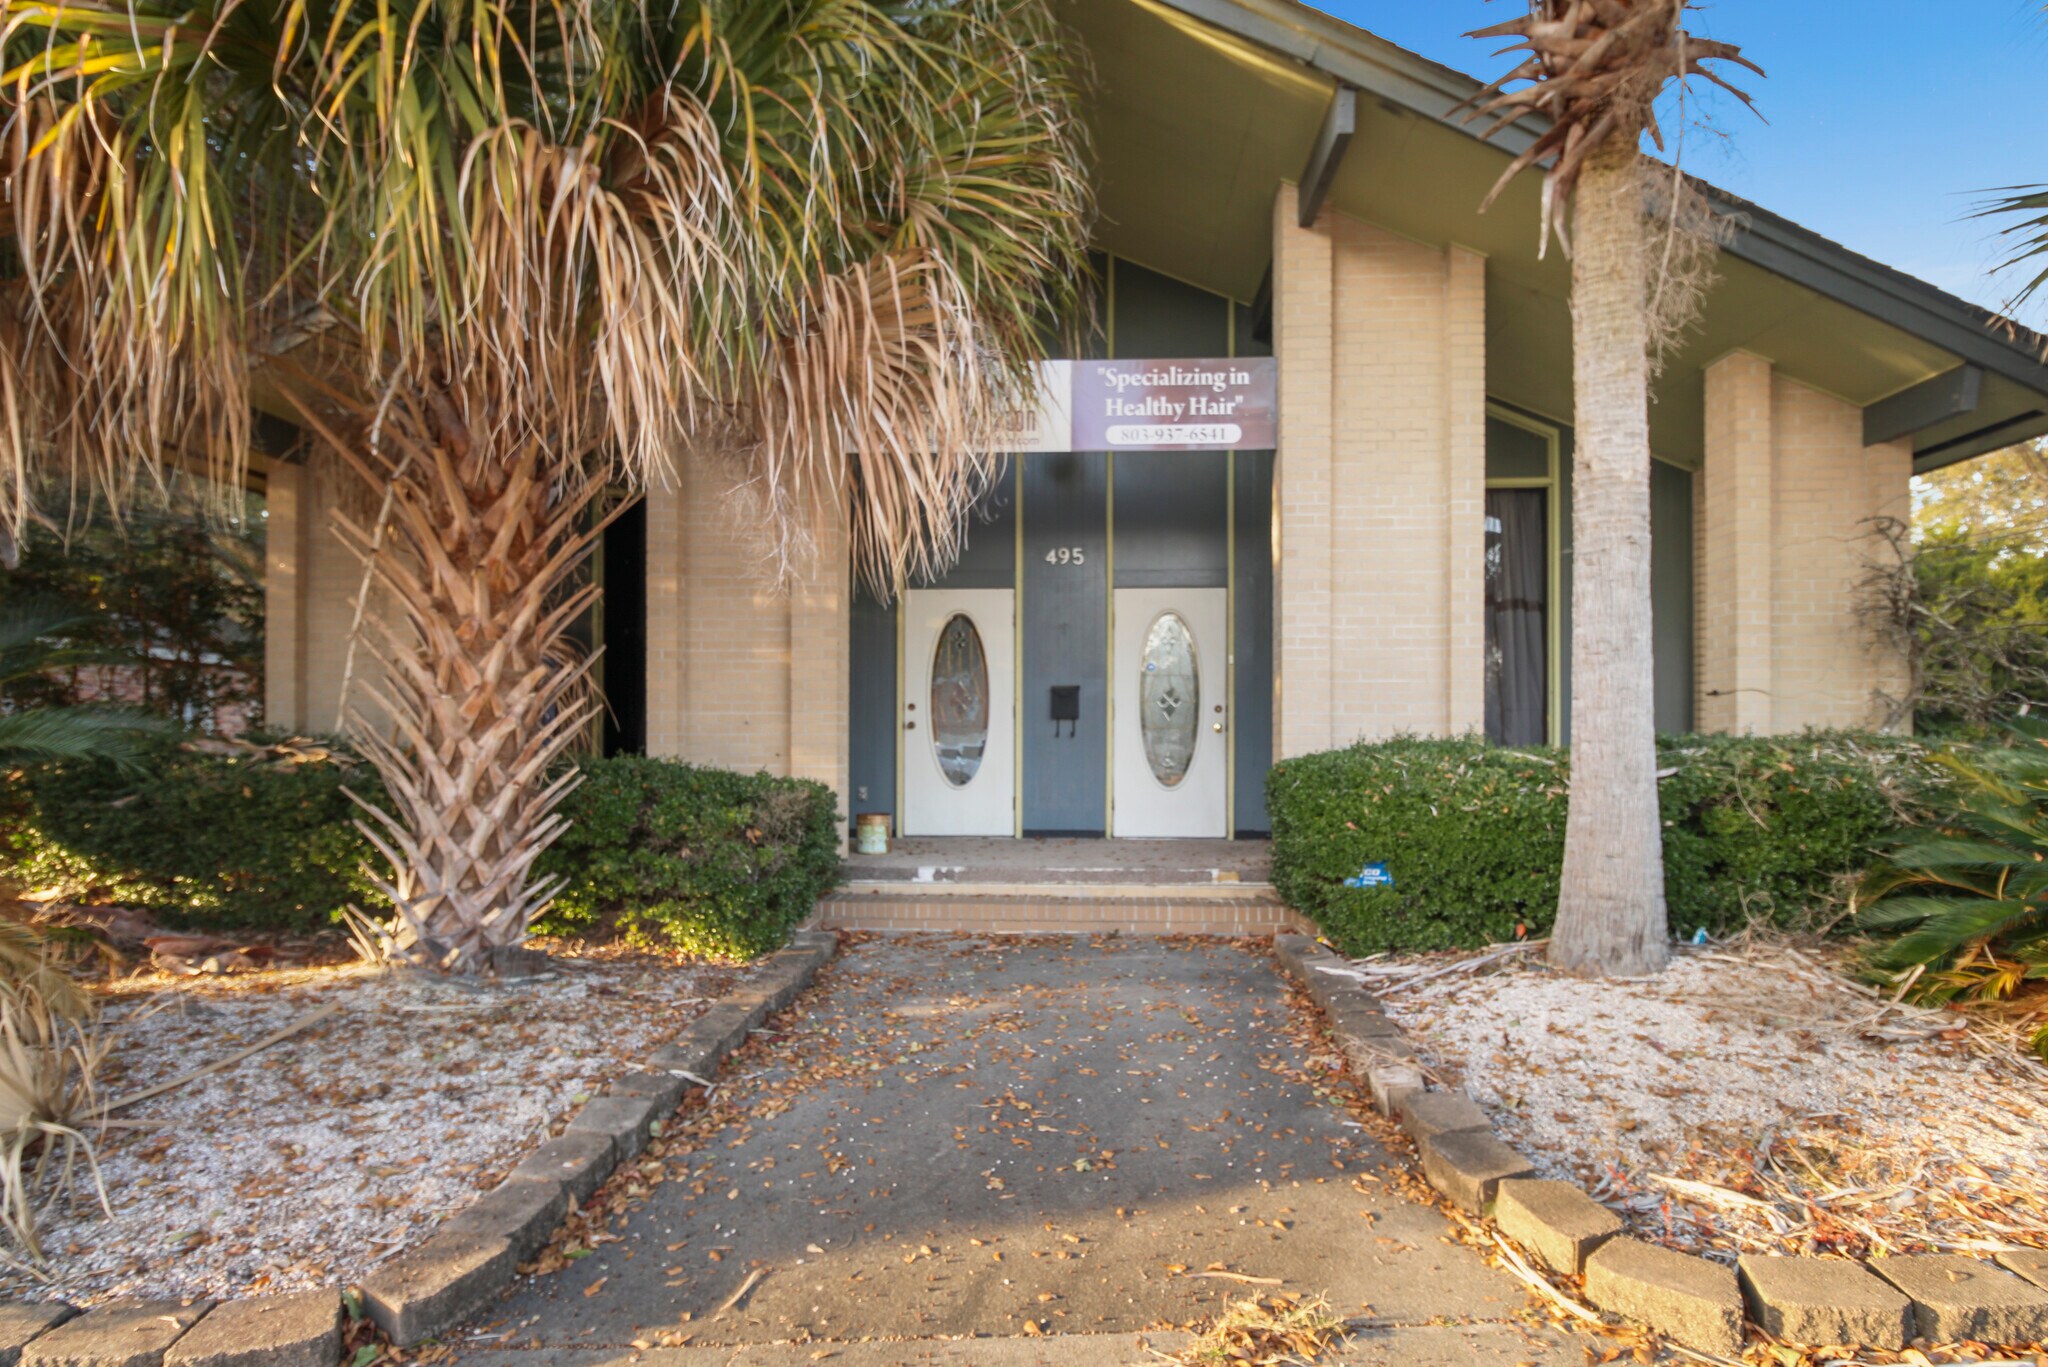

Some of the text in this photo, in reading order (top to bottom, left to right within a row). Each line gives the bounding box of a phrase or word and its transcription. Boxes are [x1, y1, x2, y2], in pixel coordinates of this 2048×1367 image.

[1097, 366, 1250, 393] "Specializing in
[1105, 395, 1244, 422] Healthy Hair"
[1121, 428, 1225, 441] 803-937-6541
[1045, 547, 1085, 566] 495
